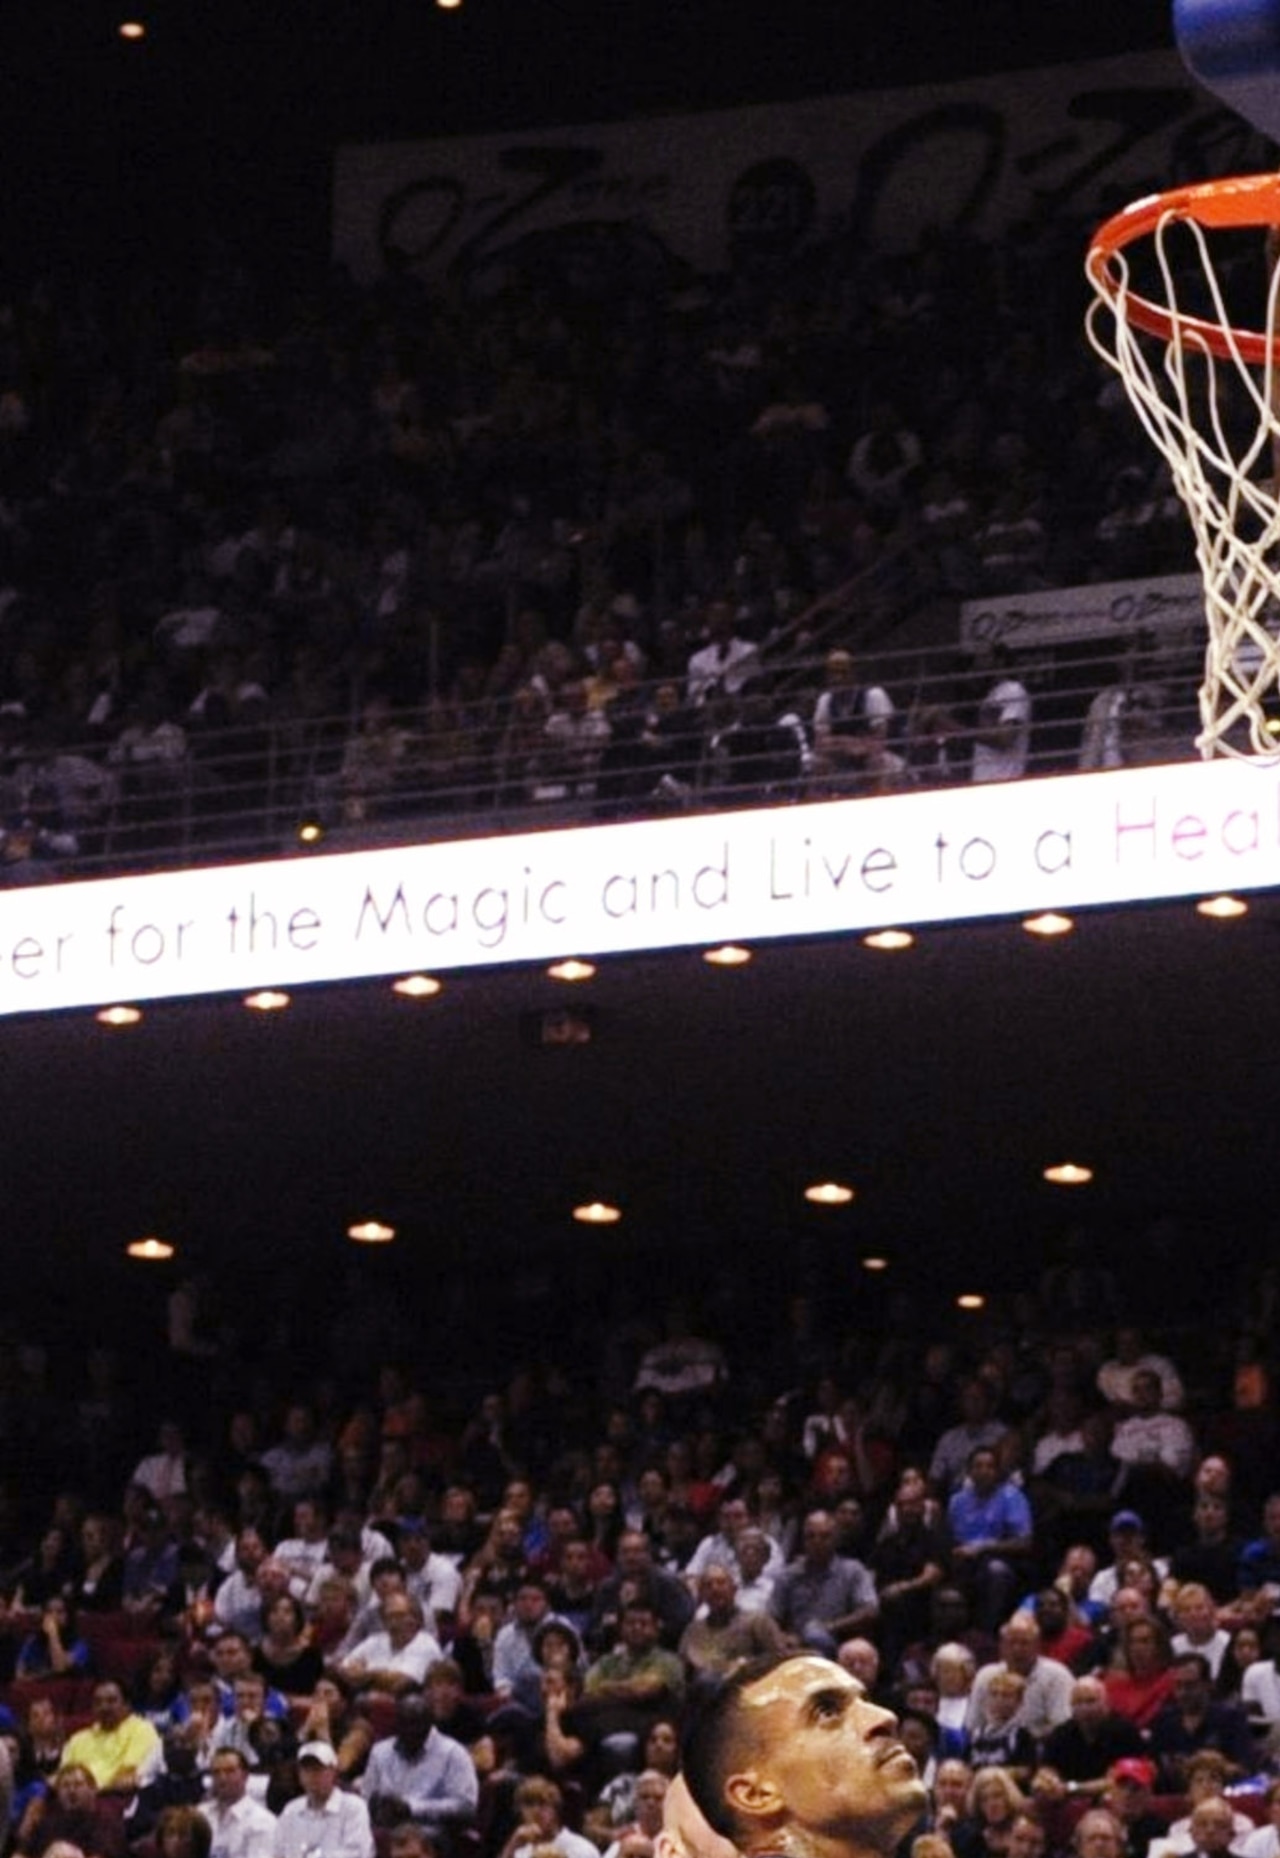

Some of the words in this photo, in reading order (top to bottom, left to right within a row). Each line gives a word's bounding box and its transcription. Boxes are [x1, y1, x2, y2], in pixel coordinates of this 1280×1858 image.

[0, 928, 73, 980] er
[107, 905, 195, 966] for
[227, 891, 321, 954] the
[354, 866, 567, 949] Magic
[601, 840, 730, 920] and
[769, 836, 898, 901] Live
[934, 832, 998, 884] to
[1033, 829, 1073, 874] a
